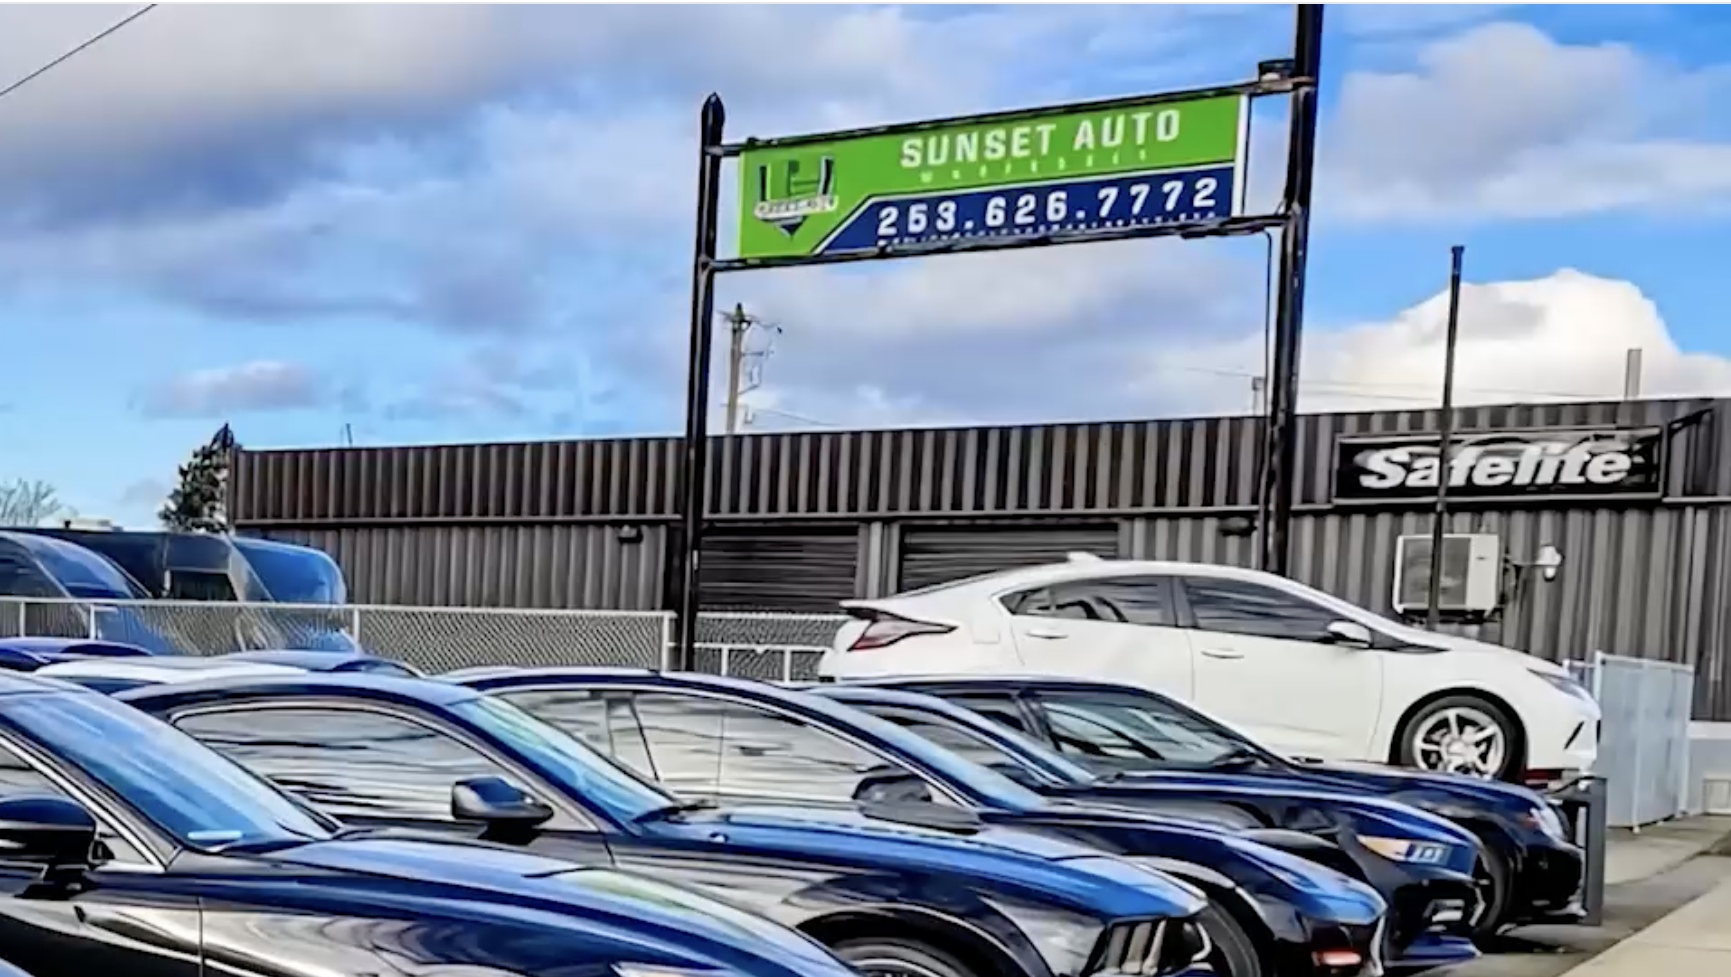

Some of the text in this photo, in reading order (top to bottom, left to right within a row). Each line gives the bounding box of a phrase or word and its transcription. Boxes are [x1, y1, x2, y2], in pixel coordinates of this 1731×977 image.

[900, 123, 1057, 169] SUNSET
[1073, 109, 1181, 151] AUTO
[1356, 443, 1632, 489] Safelite
